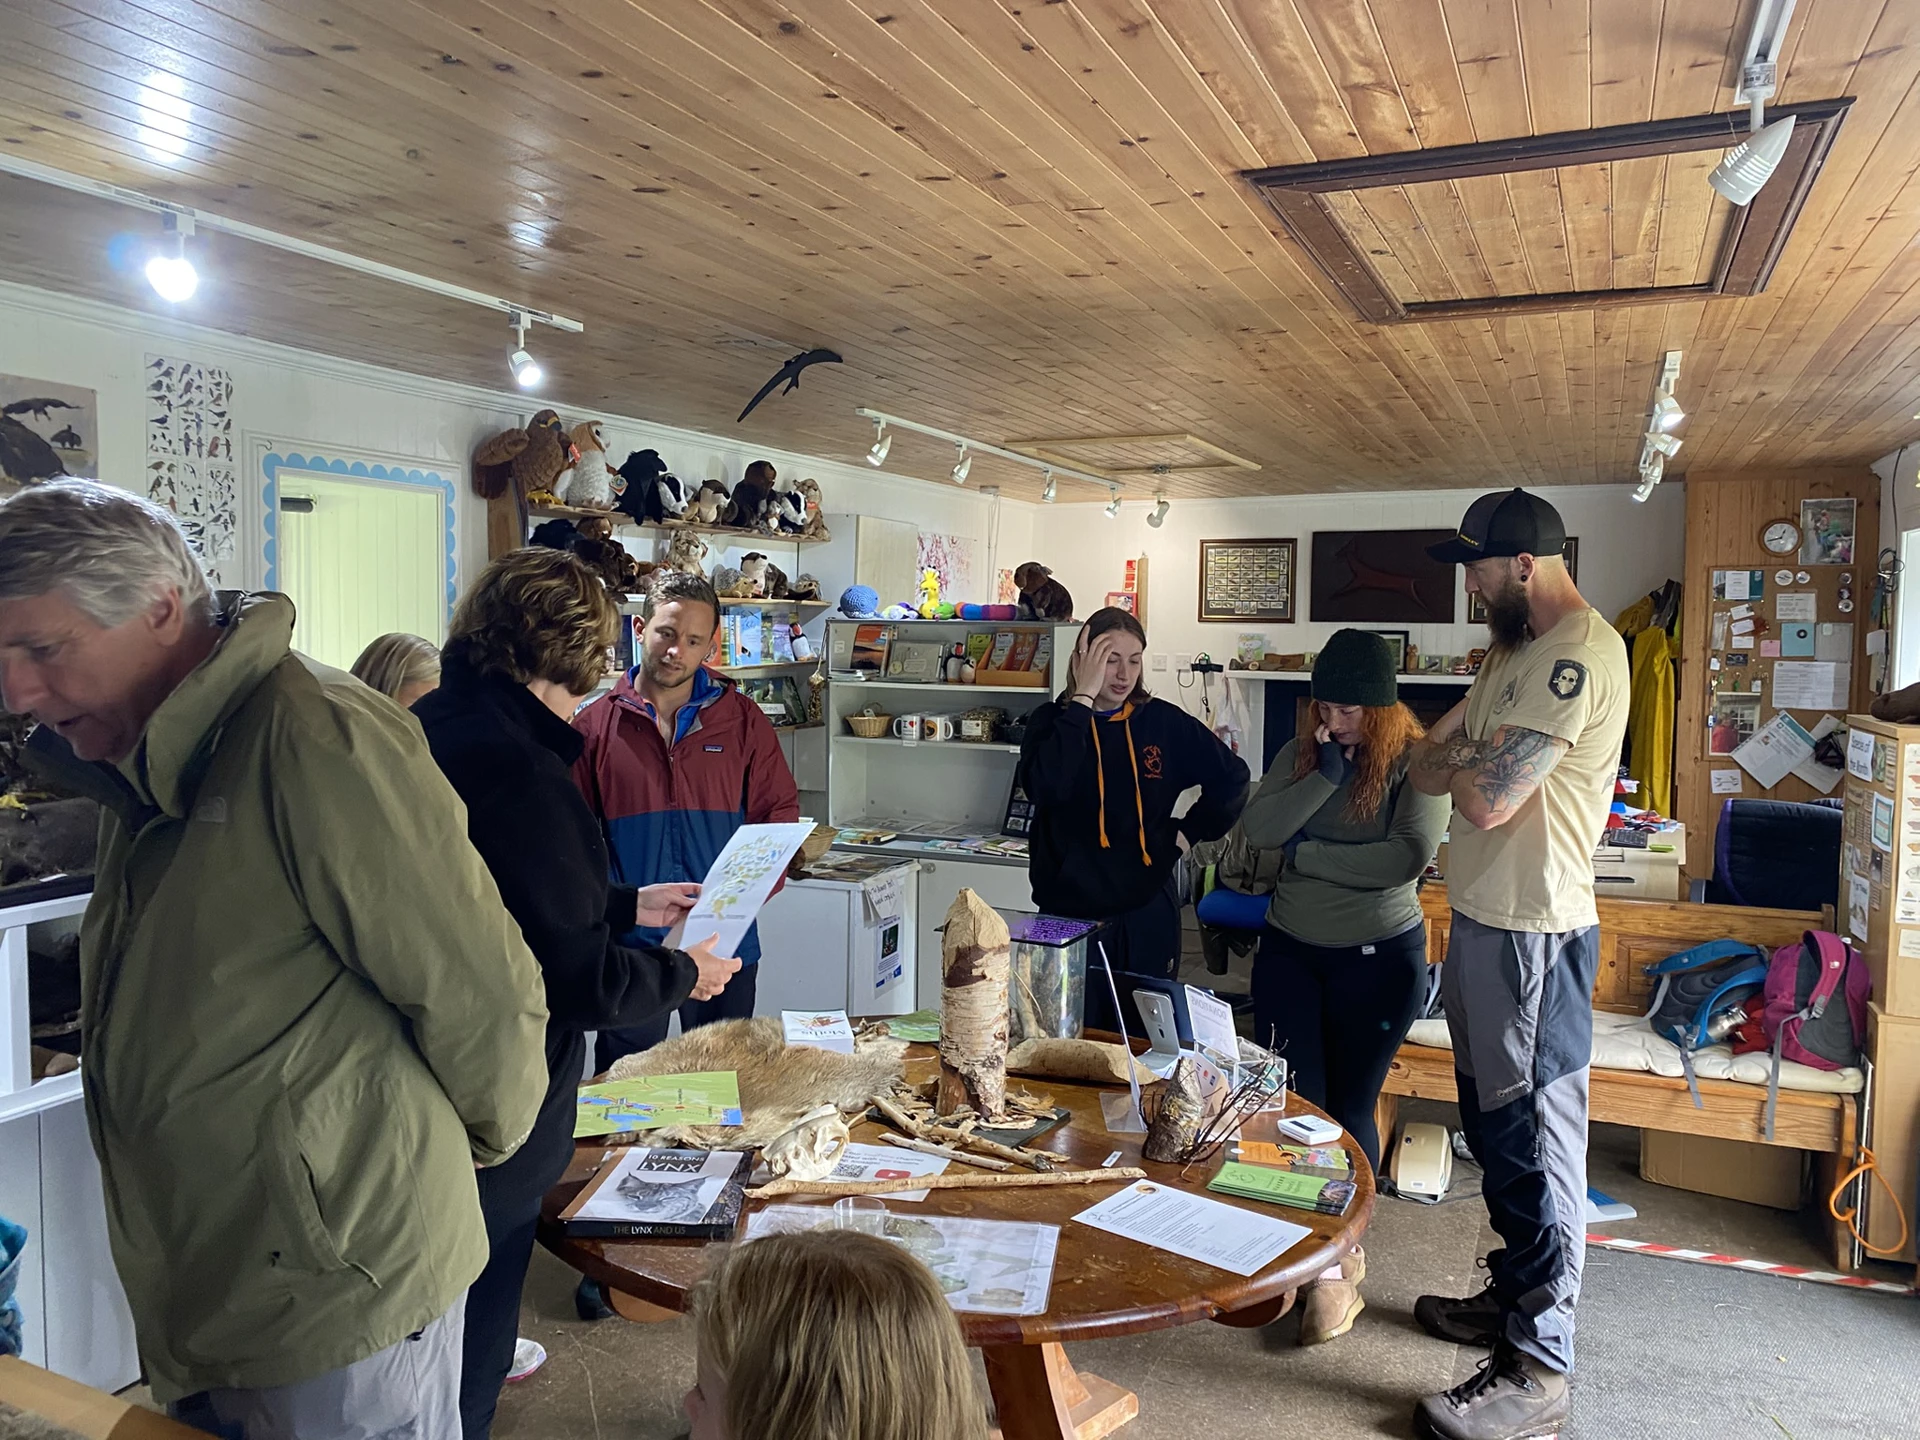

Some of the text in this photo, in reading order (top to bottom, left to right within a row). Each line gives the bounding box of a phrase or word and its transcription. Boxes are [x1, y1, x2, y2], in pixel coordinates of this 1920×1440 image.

[801, 1029, 846, 1037] Moths
[640, 1162, 700, 1172] LYNX
[613, 1226, 686, 1235] THE LYNX AND US
